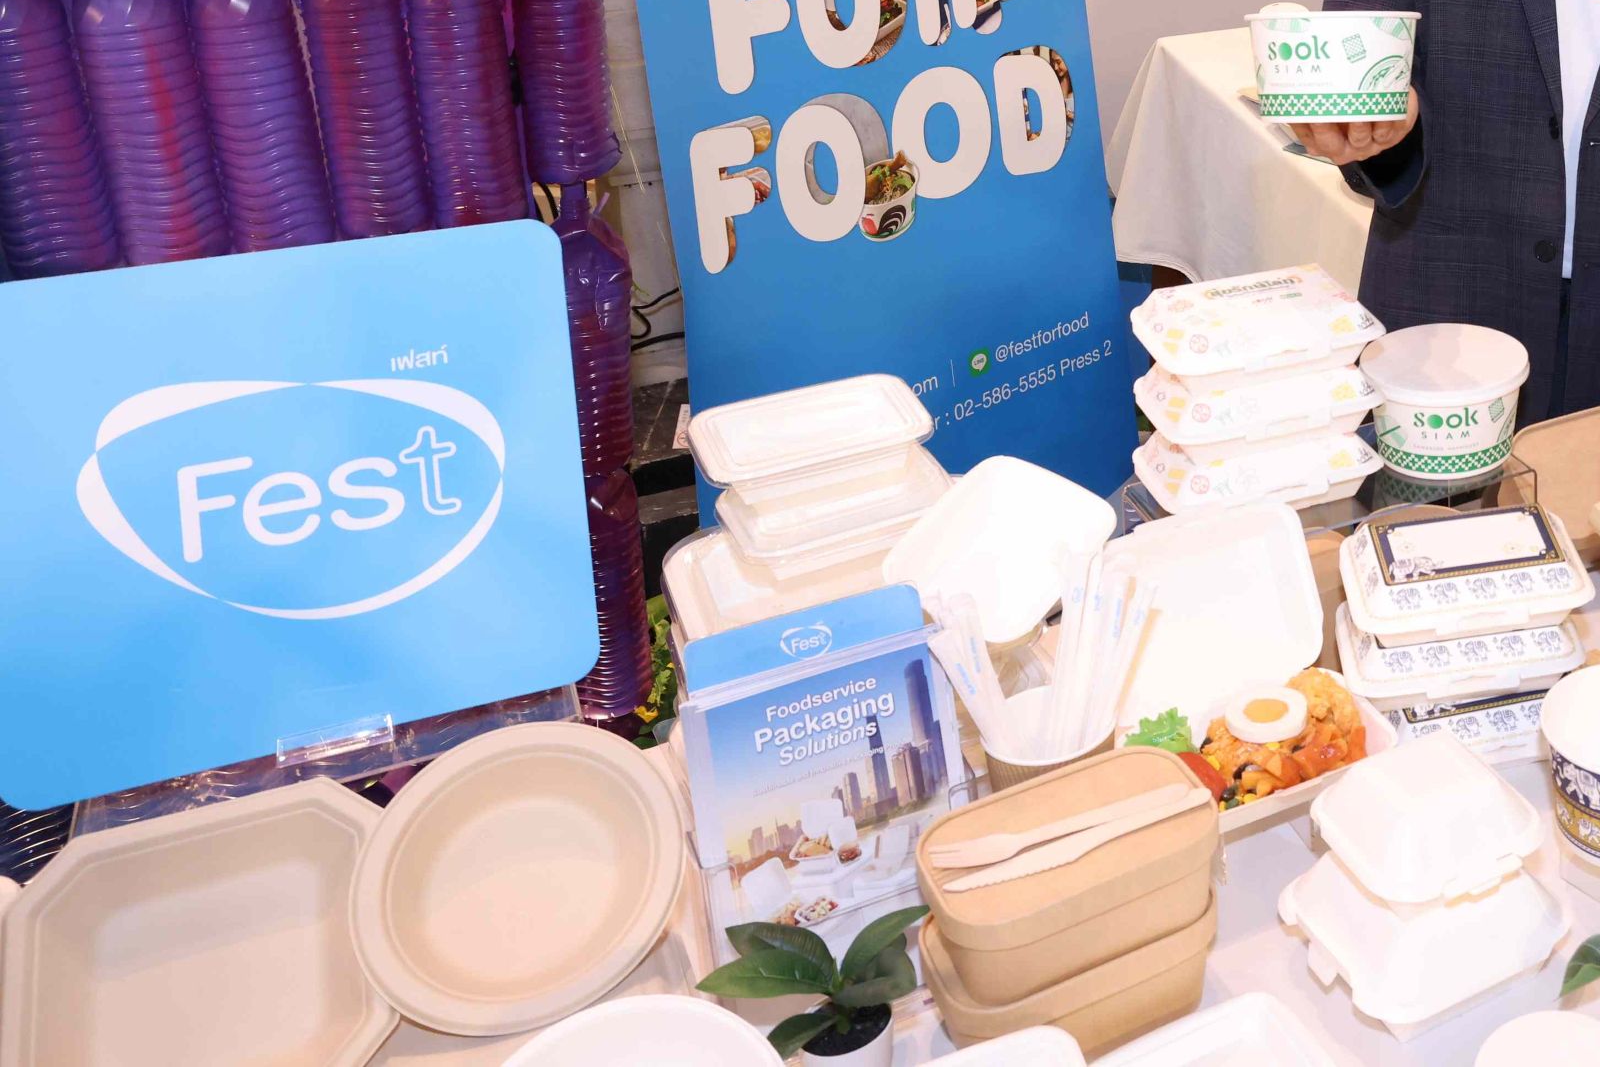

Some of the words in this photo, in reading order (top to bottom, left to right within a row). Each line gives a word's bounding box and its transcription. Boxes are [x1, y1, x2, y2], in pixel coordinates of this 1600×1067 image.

[1274, 65, 1321, 74] SIAM
[689, 46, 1075, 274] FOOD
[995, 311, 1089, 363] @festforfood
[954, 364, 1056, 421] 02-586-5555
[1060, 350, 1101, 376] Press
[1103, 339, 1113, 356] 2
[1421, 430, 1471, 440] SIAM
[176, 425, 463, 563] Fest
[790, 631, 828, 653] Fest
[754, 692, 895, 753] Packaging
[766, 678, 877, 722] Foodservice
[779, 721, 878, 766] Solutions
